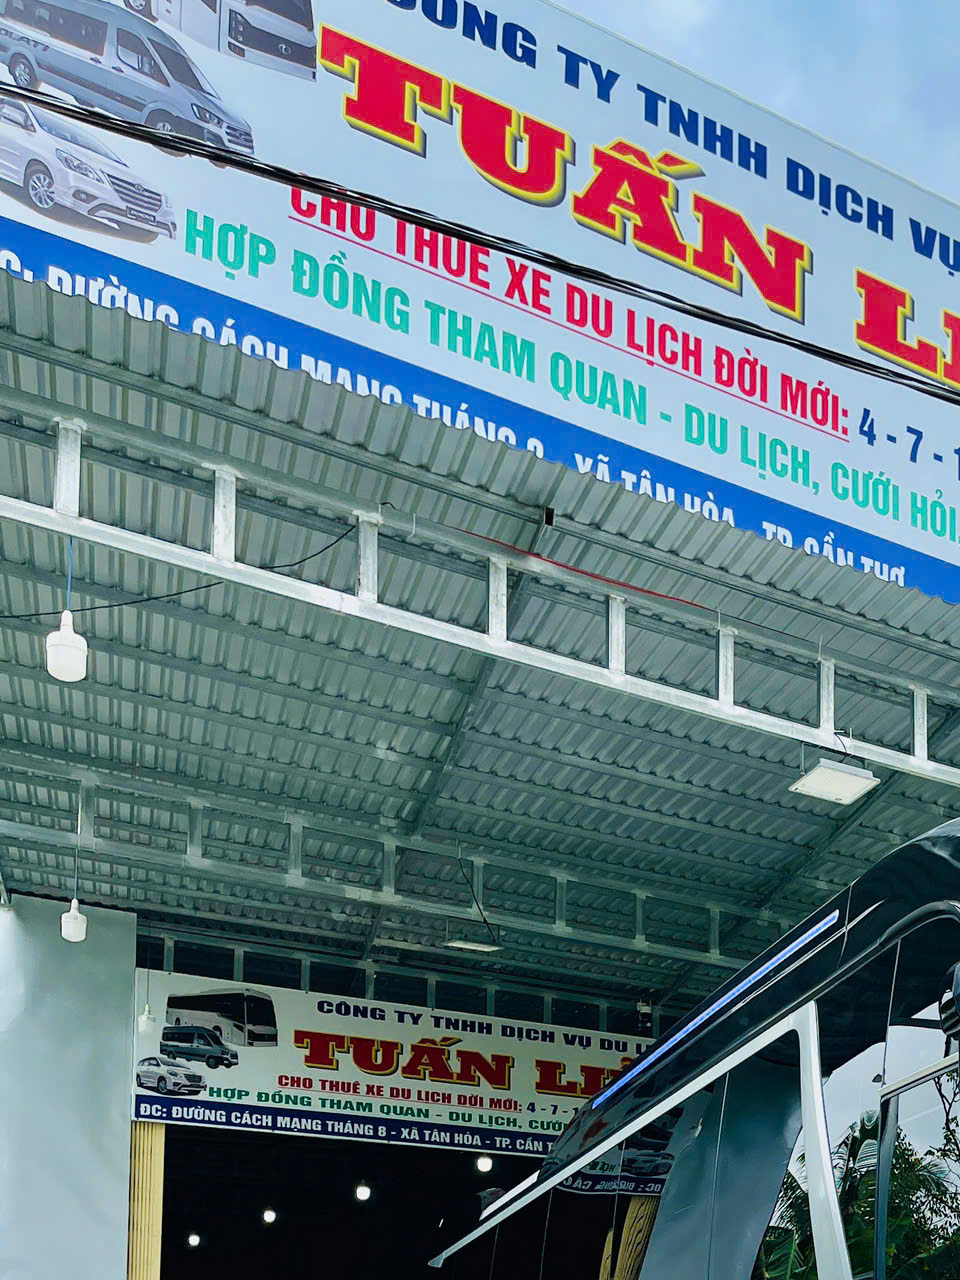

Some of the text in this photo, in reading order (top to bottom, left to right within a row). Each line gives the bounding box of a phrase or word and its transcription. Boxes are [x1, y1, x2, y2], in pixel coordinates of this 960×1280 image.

[319, 22, 813, 325] TUẤN
[557, 45, 621, 104] TY
[637, 83, 768, 180] TNHH
[786, 156, 894, 241] DỊCH
[185, 208, 277, 280] HỢP
[291, 249, 410, 335] ĐỒNG
[424, 299, 536, 383] THAM
[550, 351, 647, 426] QUAN
[685, 402, 728, 455] DU
[740, 425, 819, 495] LỊCH,
[831, 462, 900, 521] CƯỚI
[504, 256, 551, 315] XE
[565, 282, 613, 338] DU
[626, 308, 702, 376] LỊCH
[713, 345, 769, 404] ĐỜI
[780, 371, 849, 437] MỚI:
[859, 407, 877, 447] 4
[906, 425, 923, 463] 7
[317, 1000, 386, 1021] CÔNG
[394, 1009, 423, 1025] TY
[430, 1014, 493, 1035] TNHH
[501, 1024, 555, 1043] DỊCH
[563, 1033, 592, 1050] VỤ
[599, 1038, 628, 1052] DU
[293, 1029, 515, 1091] TUẤN
[139, 1103, 168, 1118] ĐC:
[171, 1105, 227, 1123] ĐƯỜNG
[230, 1110, 273, 1127] CÁCH
[276, 1116, 322, 1132] MẠNG
[325, 1120, 374, 1136] THÁNG
[377, 1126, 387, 1137] 8
[400, 1126, 420, 1141] XÃ
[423, 1128, 451, 1144] TÂN
[278, 1074, 313, 1089] CHO
[318, 1078, 361, 1094] THUÊ
[365, 1083, 385, 1097] XE
[389, 1086, 412, 1100] DU
[526, 1102, 536, 1113] 4
[550, 1104, 558, 1115] 7
[318, 1097, 373, 1113] THAM
[379, 1103, 430, 1119] QUAN
[448, 1111, 473, 1123] DU
